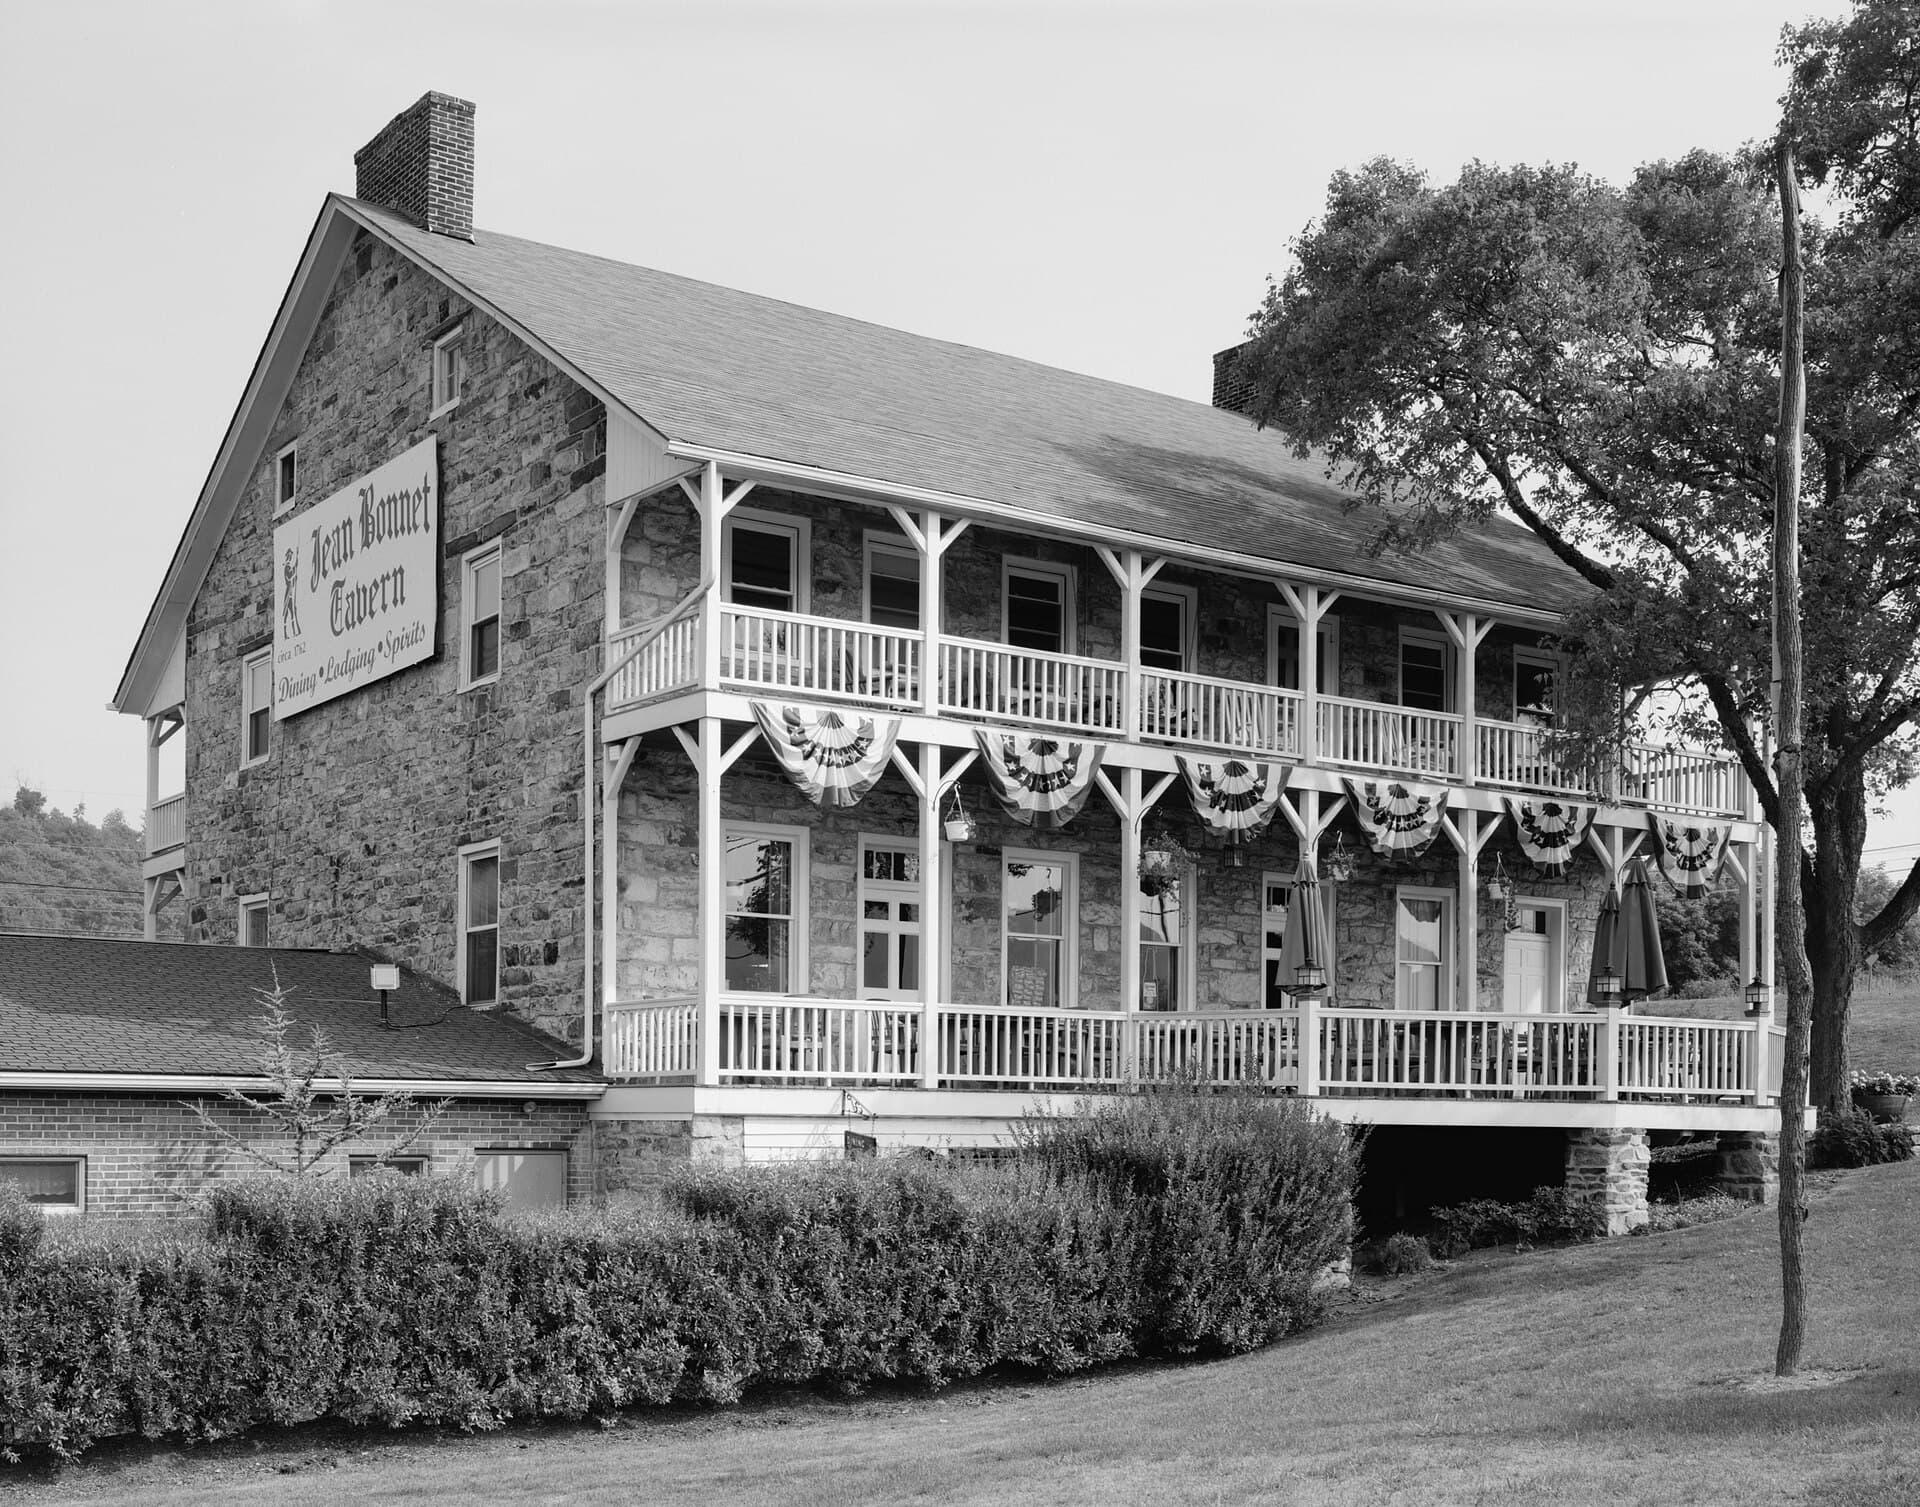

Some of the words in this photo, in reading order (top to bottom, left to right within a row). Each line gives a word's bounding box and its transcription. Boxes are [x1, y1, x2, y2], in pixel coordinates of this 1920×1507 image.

[311, 515, 354, 593] Jean
[359, 472, 431, 551] Bonnet
[330, 564, 406, 637] Tavern
[278, 672, 317, 703] Dining
[324, 647, 375, 684] Lodging
[384, 620, 426, 664] Spirits
